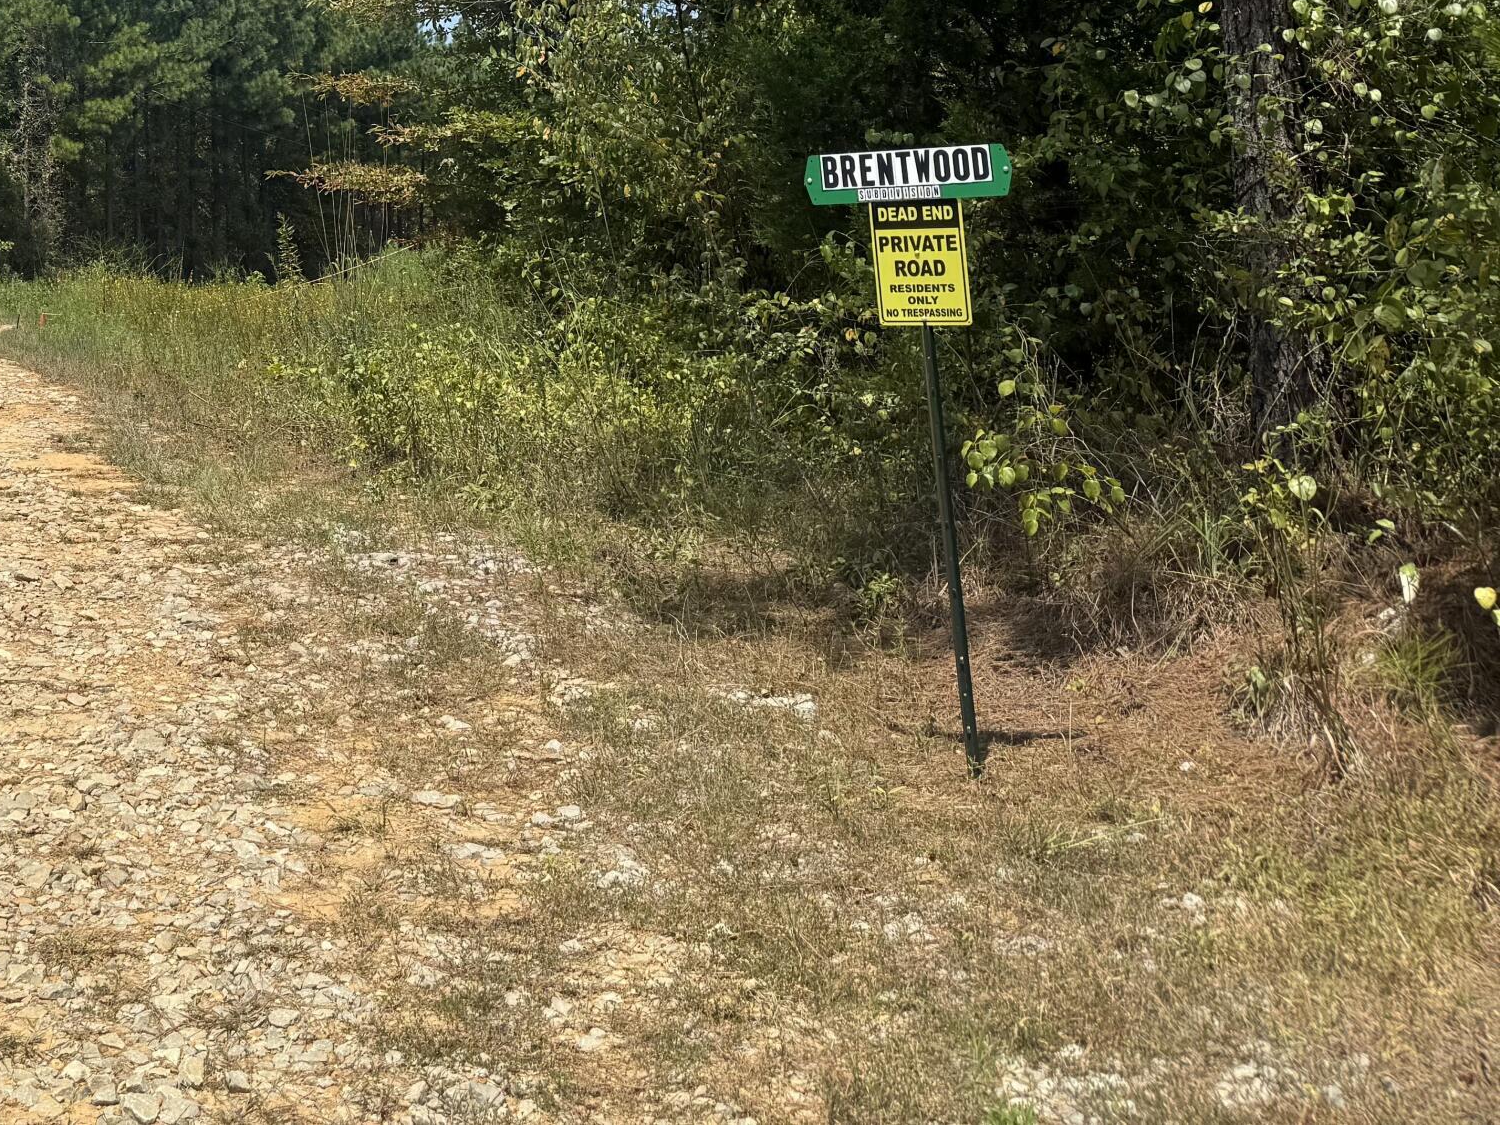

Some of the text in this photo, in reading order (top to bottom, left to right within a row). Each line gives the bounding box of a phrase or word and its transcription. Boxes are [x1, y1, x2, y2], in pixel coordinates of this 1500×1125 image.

[821, 146, 990, 189] BRENTWOOD
[859, 186, 940, 200] SUBDIVISION
[877, 205, 953, 222] DEAD END
[878, 234, 958, 253] PRIVATE
[894, 259, 946, 277] ROAD
[889, 283, 955, 293] RESIDENTS
[907, 295, 939, 305] ONLY
[886, 308, 963, 318] NO TRESPASSING
